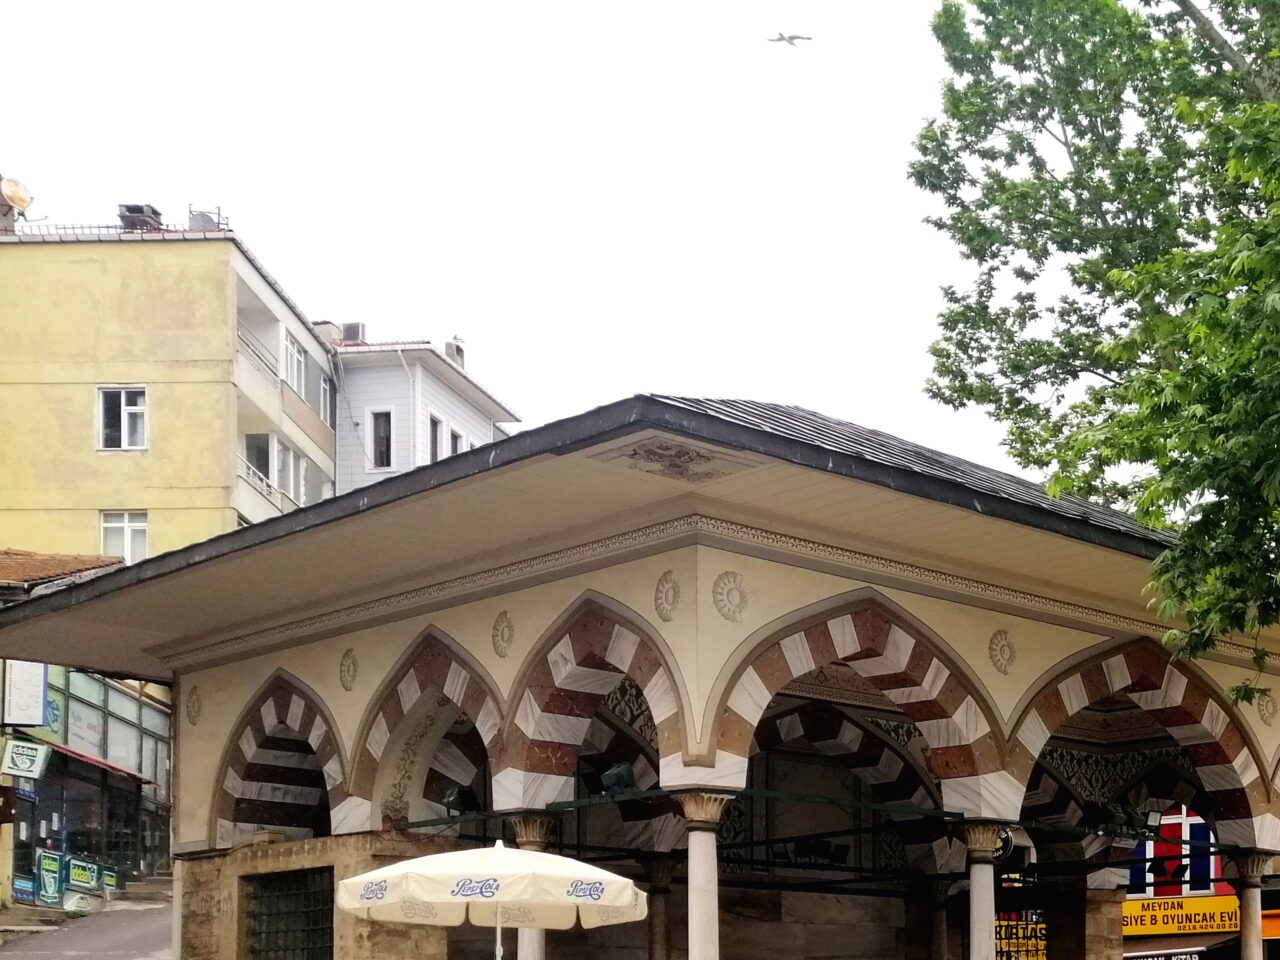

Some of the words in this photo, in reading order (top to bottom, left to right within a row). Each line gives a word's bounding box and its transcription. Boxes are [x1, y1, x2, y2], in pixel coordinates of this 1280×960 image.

[1141, 901, 1183, 912] MEYDAN
[1150, 914, 1158, 925] &
[1162, 912, 1216, 925] OYUNCAK
[1220, 908, 1238, 922] EVİ
